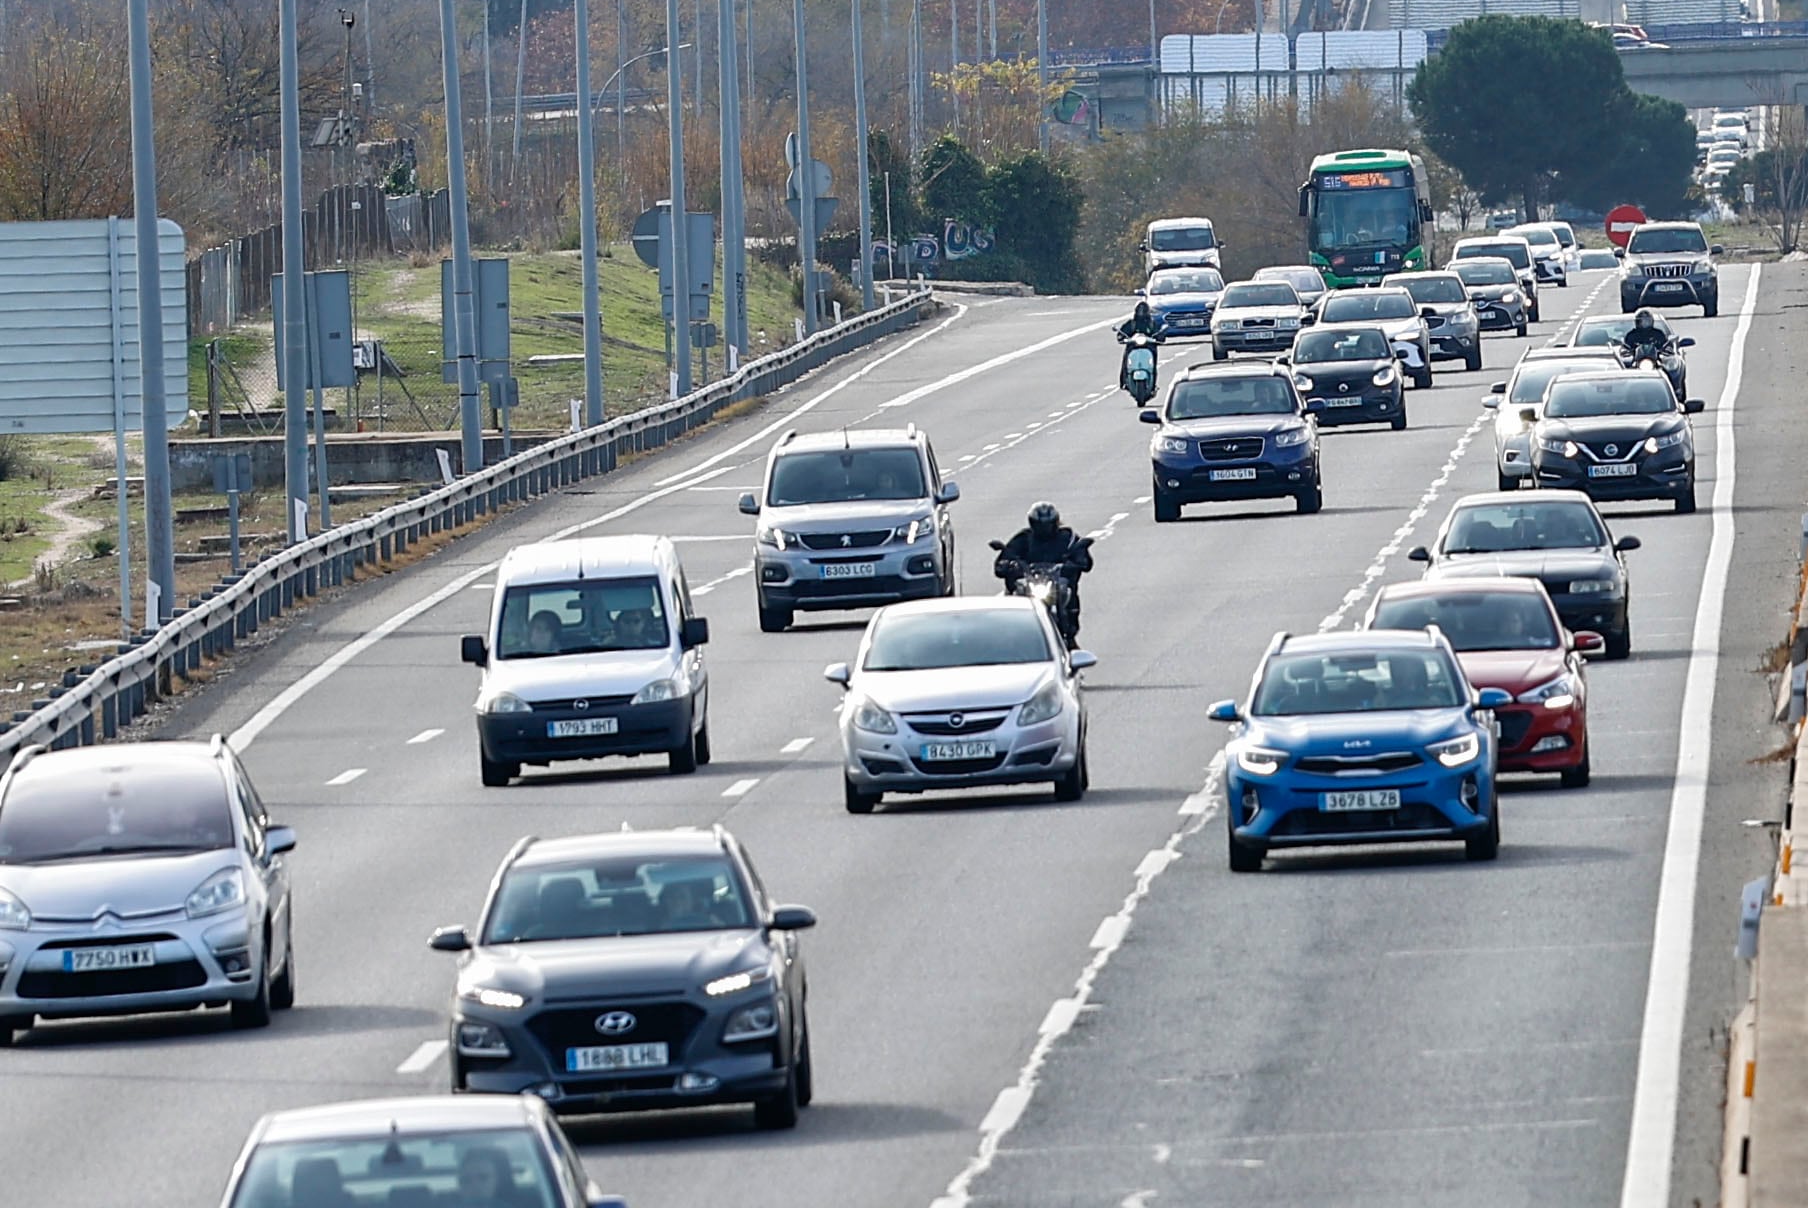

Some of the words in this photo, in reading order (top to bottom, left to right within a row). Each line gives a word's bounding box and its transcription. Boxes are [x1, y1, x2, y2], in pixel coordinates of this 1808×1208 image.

[929, 743, 963, 758] 8430
[967, 742, 992, 755] GPK
[1329, 793, 1366, 808] 3678
[1369, 792, 1398, 807] LZB
[75, 950, 116, 967] 7750
[120, 948, 150, 964] HWX
